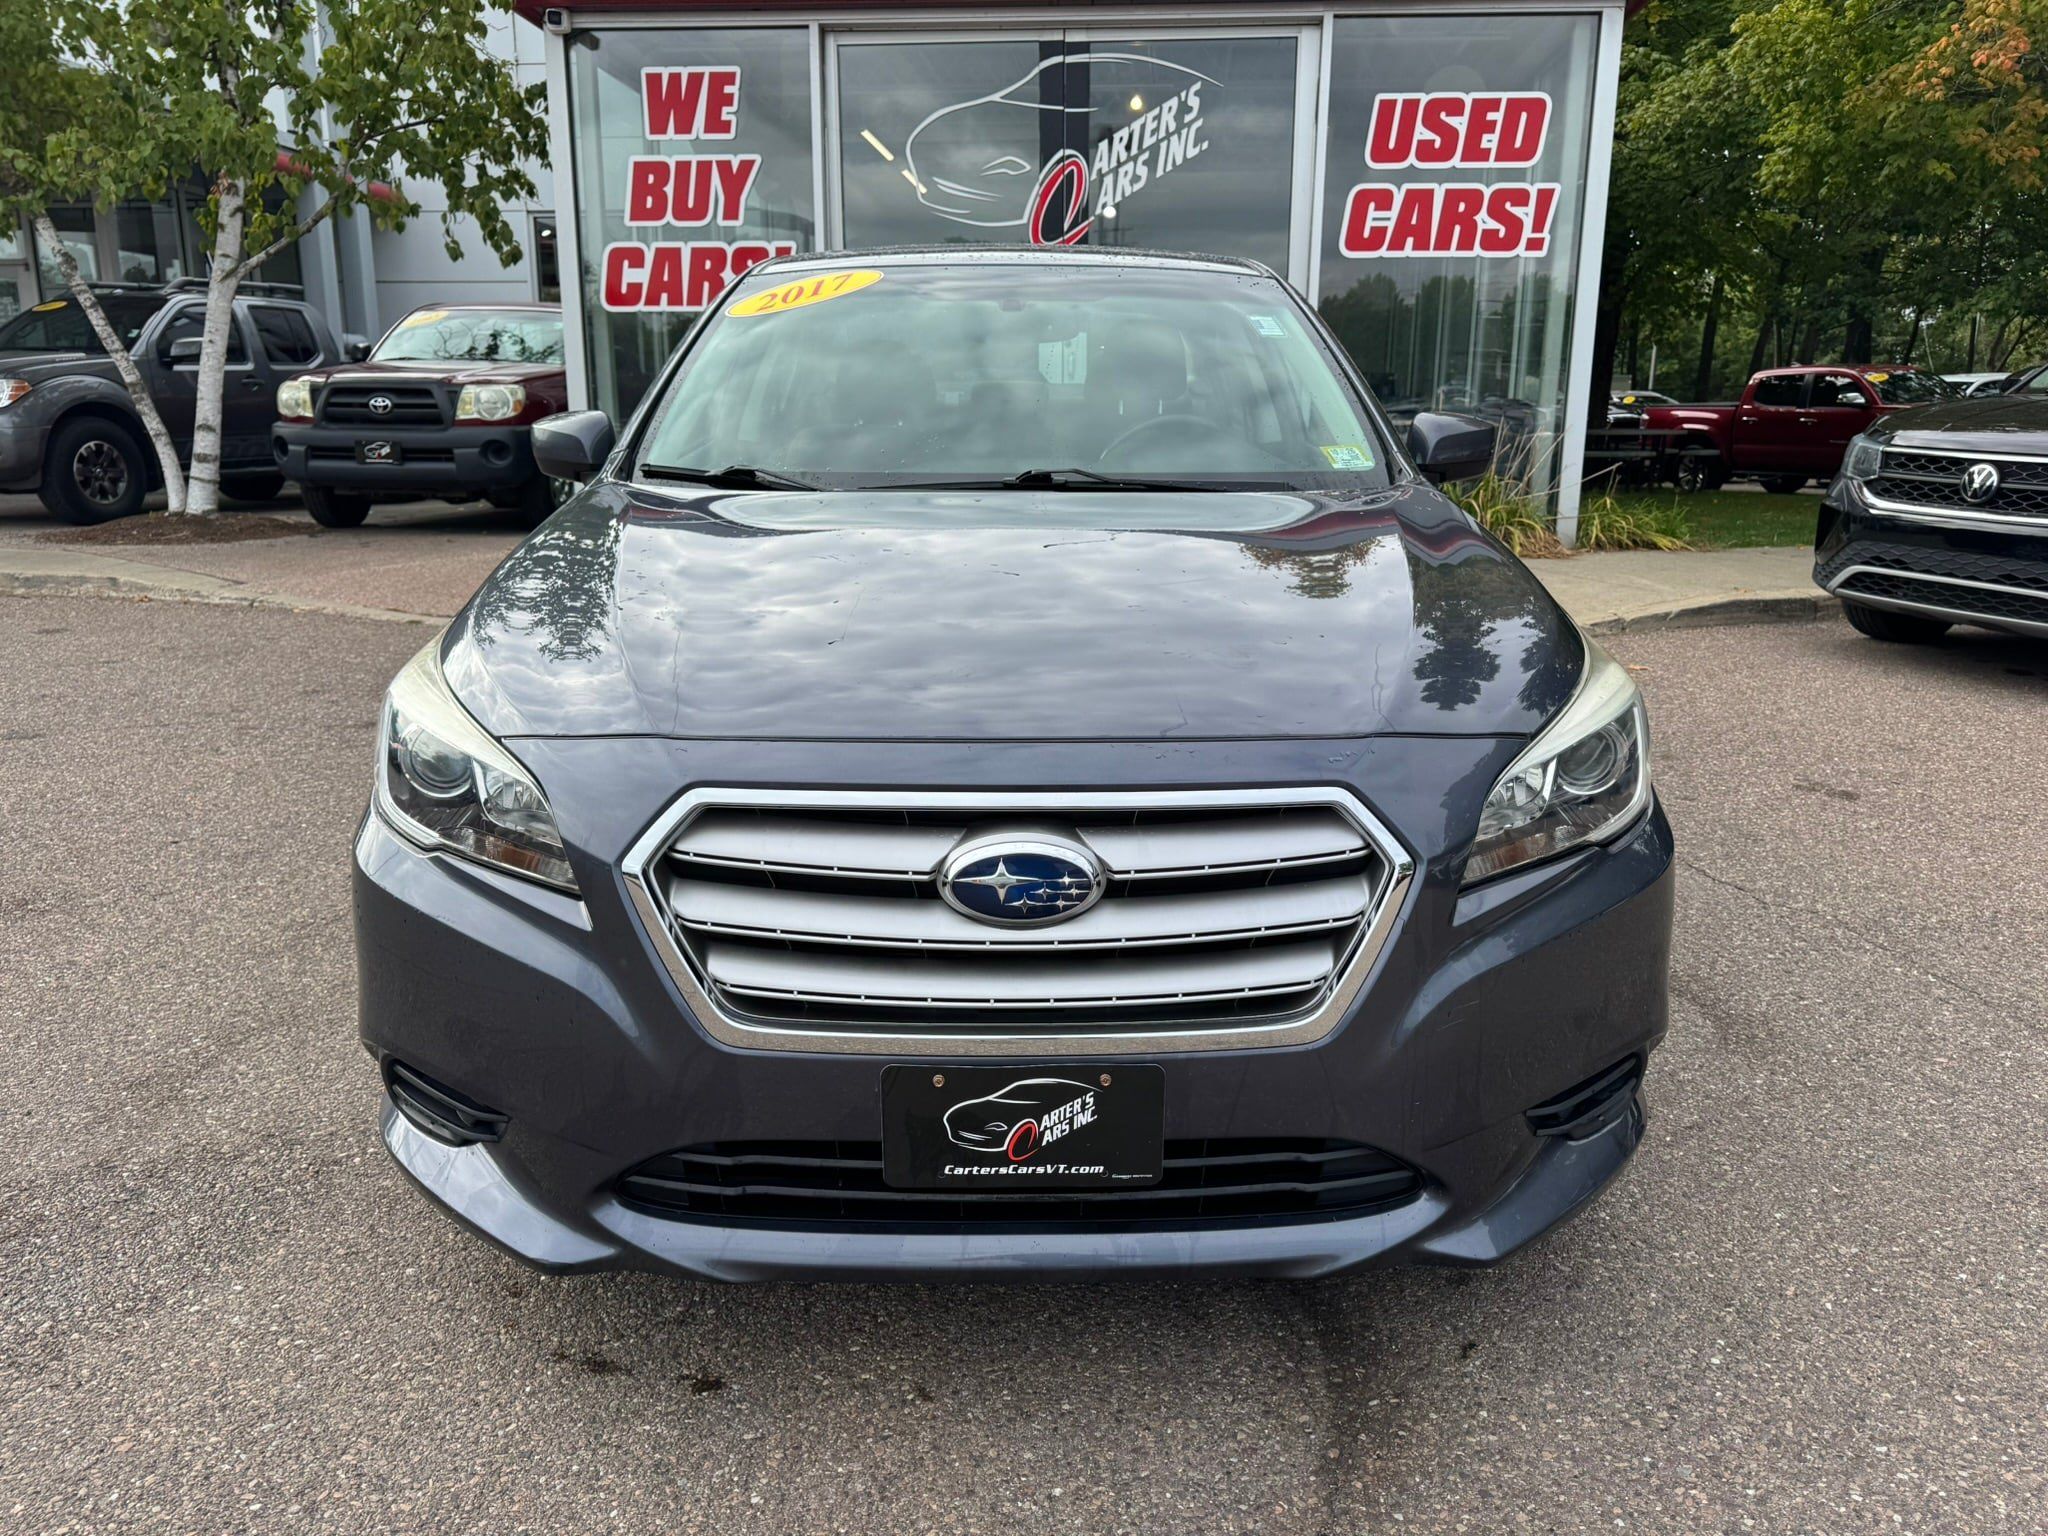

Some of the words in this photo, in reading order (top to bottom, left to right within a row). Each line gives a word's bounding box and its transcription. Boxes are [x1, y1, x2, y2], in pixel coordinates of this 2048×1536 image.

[644, 70, 738, 136] WE
[1369, 96, 1548, 164] USED
[1155, 117, 1209, 179] INC.
[628, 158, 757, 222] BUY
[1344, 187, 1557, 252] CARS!
[604, 245, 793, 307] CAR
[755, 272, 854, 312] 2017
[1073, 1105, 1098, 1130] INC.
[943, 1163, 1105, 1176] CartersCarsVT.com
